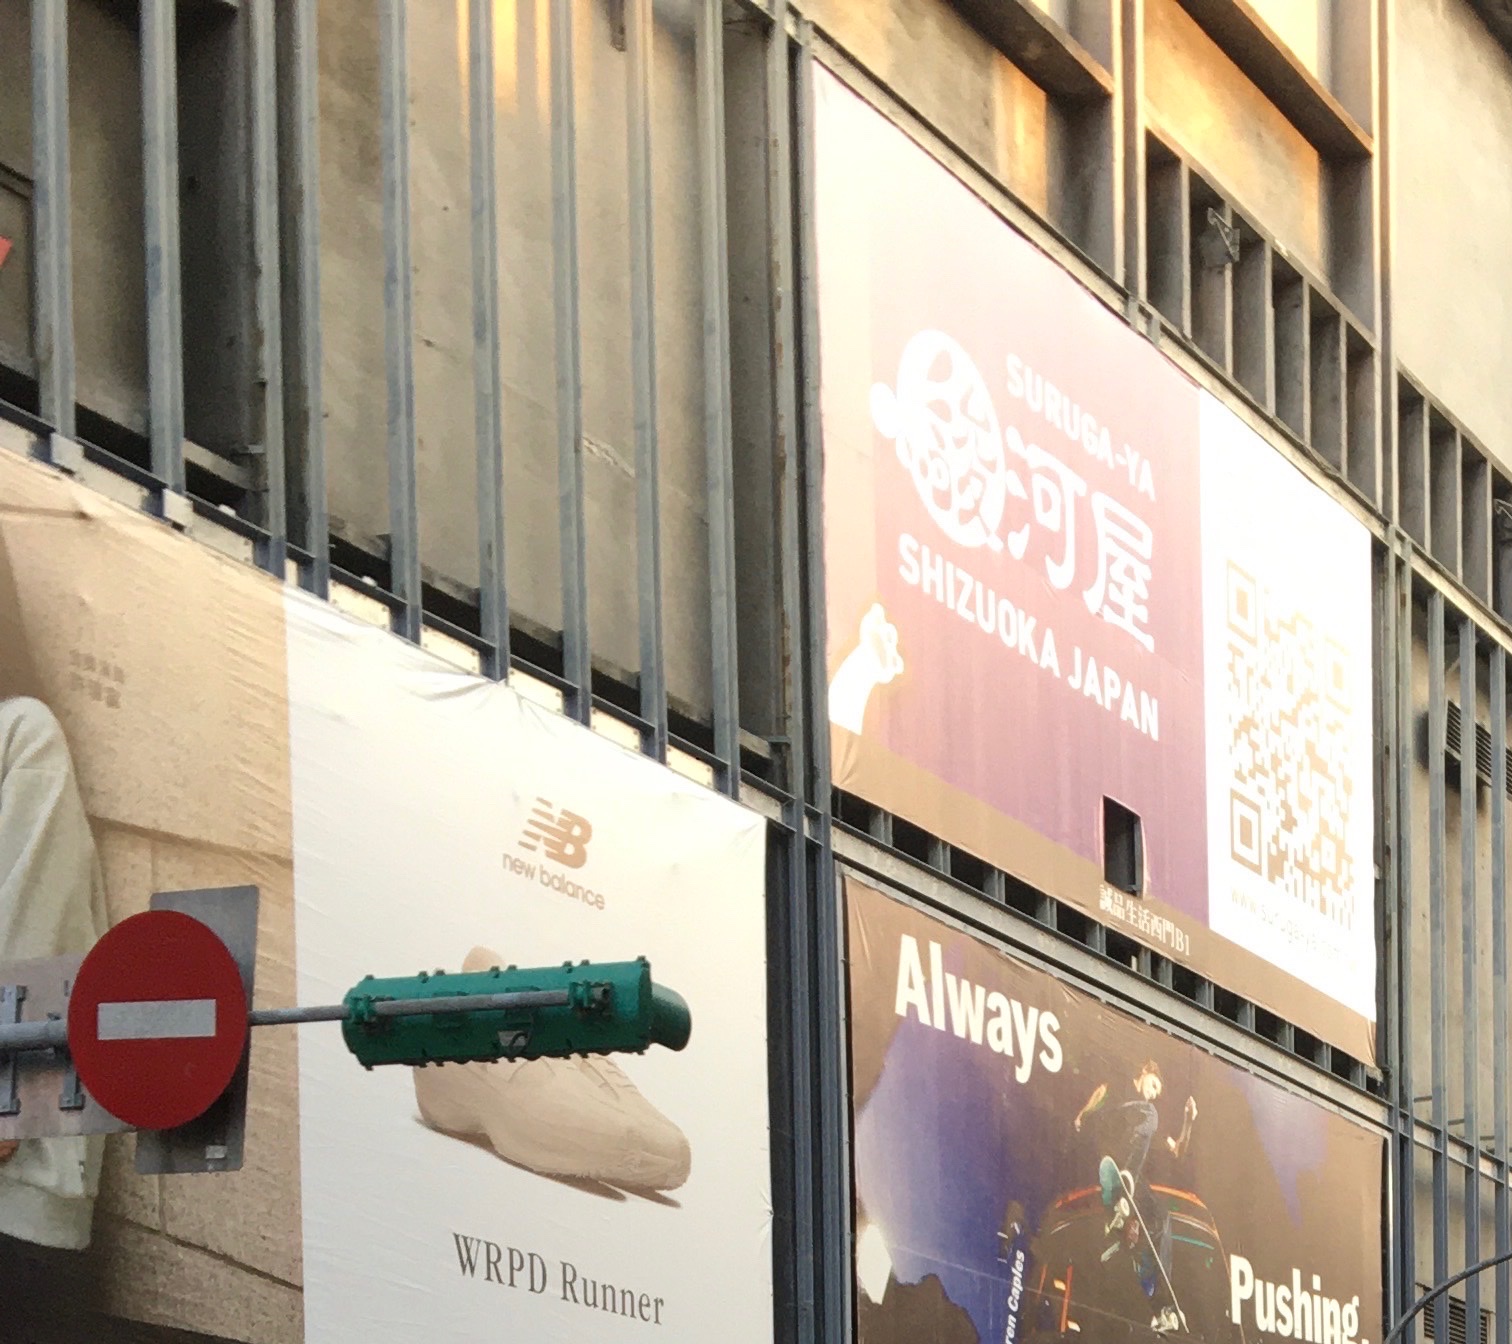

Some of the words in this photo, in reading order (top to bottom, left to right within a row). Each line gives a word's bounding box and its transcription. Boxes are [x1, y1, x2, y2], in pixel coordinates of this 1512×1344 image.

[1005, 353, 1156, 501] SURUGA-YA
[898, 532, 1061, 679] SHIZUOKA
[1067, 646, 1160, 741] JAPAN
[502, 853, 536, 881] new
[539, 864, 606, 910] balance
[893, 933, 1065, 1084] Always
[453, 1232, 548, 1296] WRPD
[561, 1260, 665, 1326] Runner
[1006, 1249, 1026, 1313] Caples
